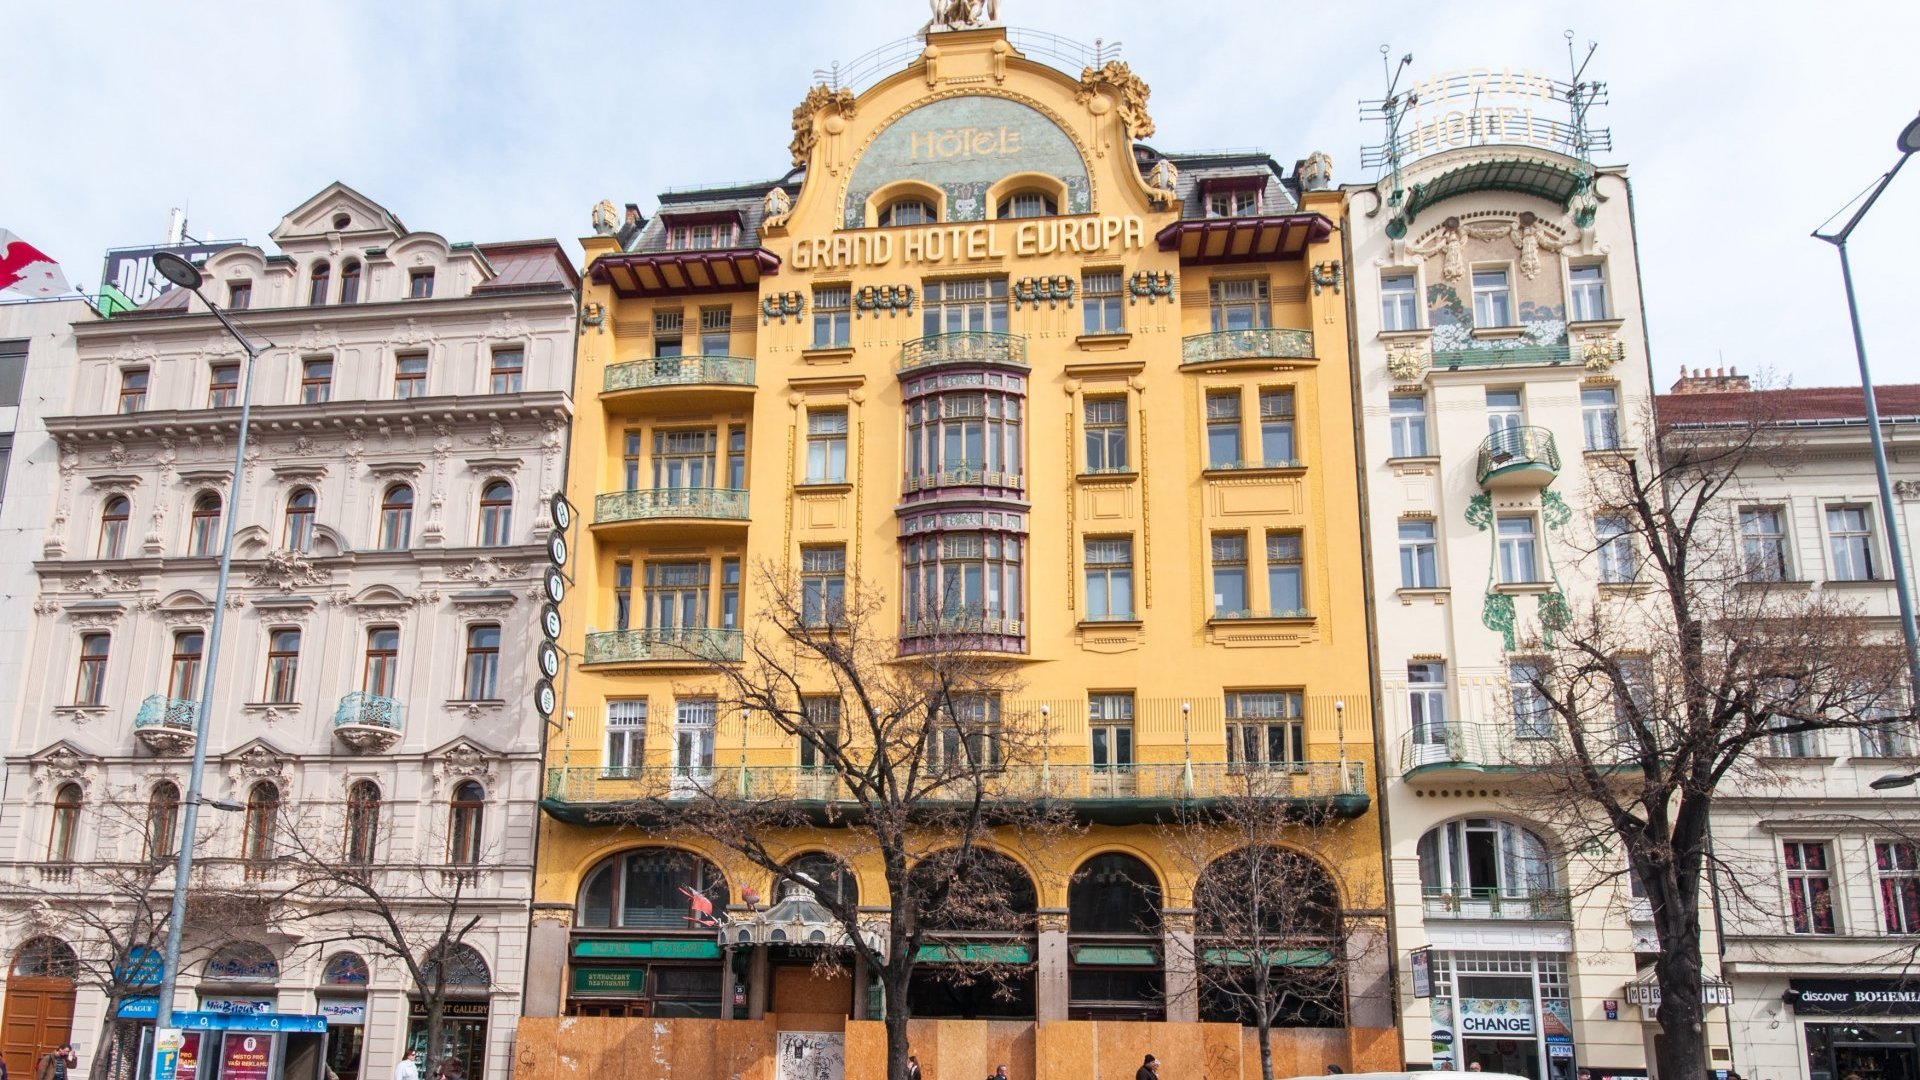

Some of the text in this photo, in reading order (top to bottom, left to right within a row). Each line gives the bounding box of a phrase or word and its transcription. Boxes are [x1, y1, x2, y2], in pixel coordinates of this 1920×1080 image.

[1413, 66, 1555, 110] MERAN
[1415, 108, 1554, 155] HOTEL
[792, 233, 893, 269] GRAND
[905, 224, 1006, 263] HOTEL
[547, 501, 567, 673] HOTEL
[453, 1005, 488, 1014] GALLERY
[1802, 990, 1920, 1002] discover BOHEMI
[1463, 1018, 1531, 1031] CHANGE
